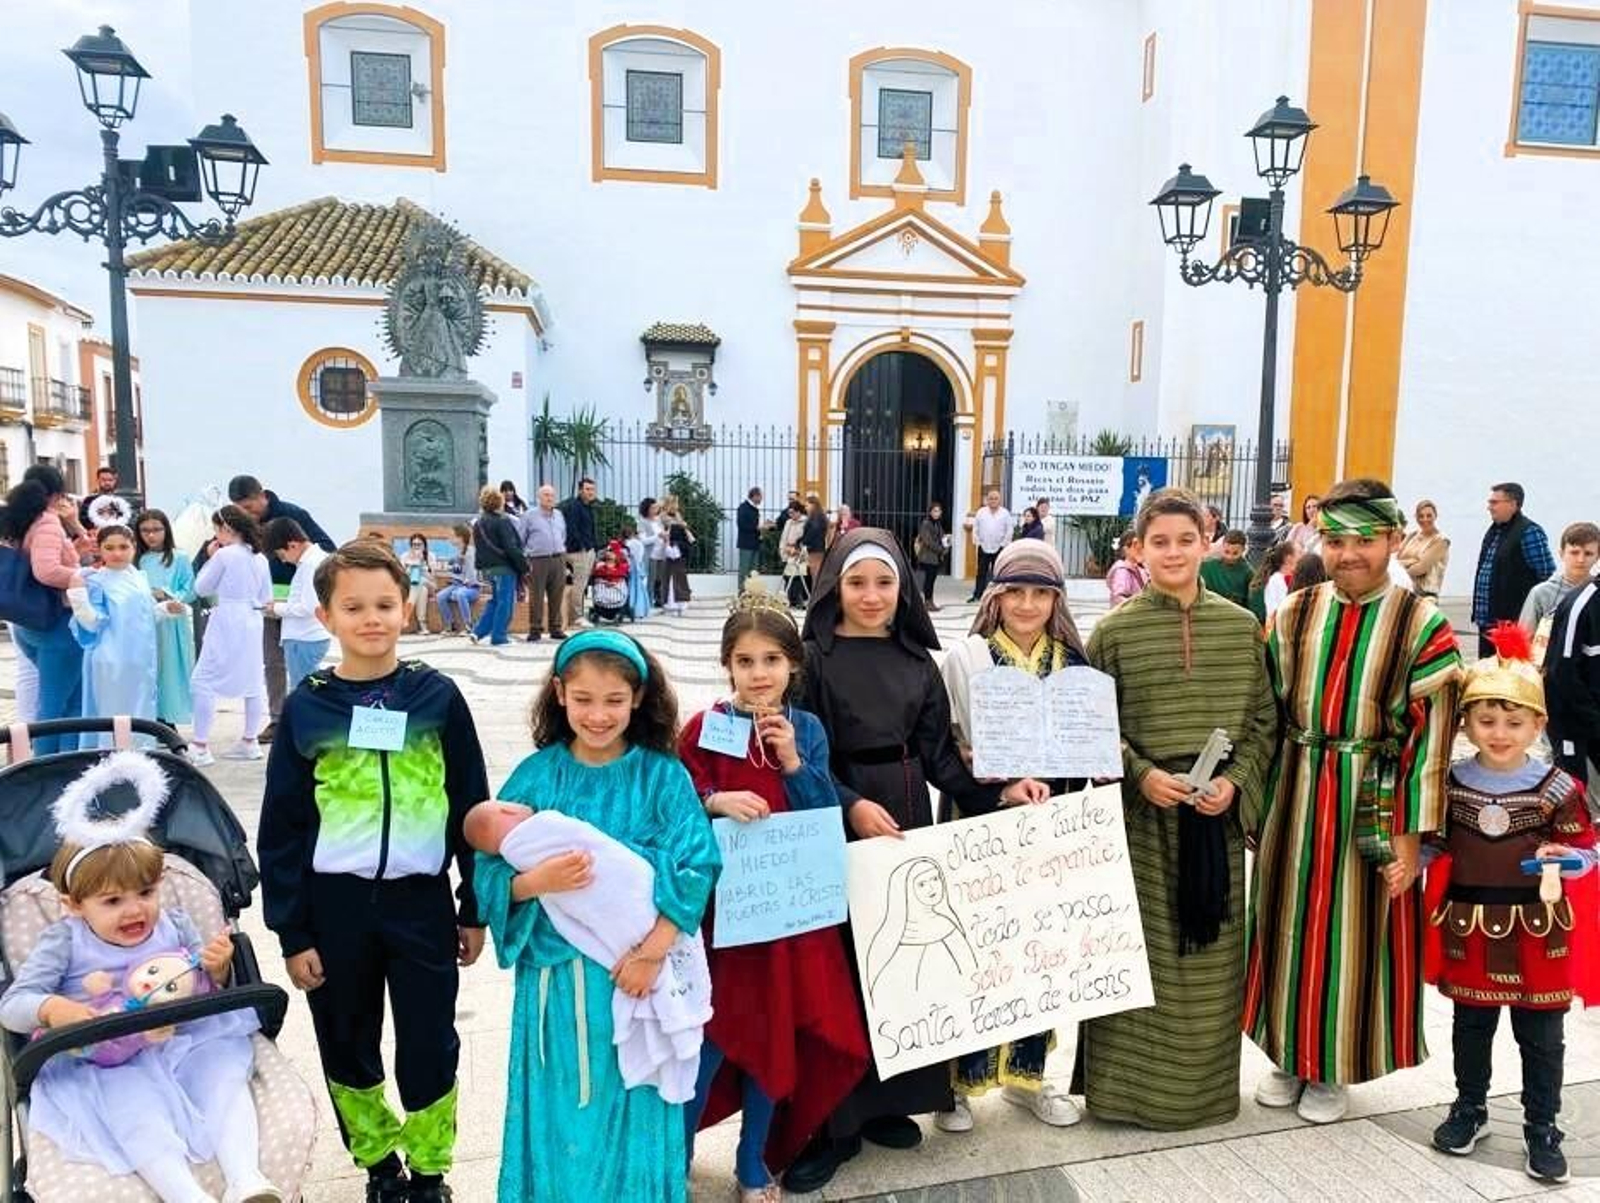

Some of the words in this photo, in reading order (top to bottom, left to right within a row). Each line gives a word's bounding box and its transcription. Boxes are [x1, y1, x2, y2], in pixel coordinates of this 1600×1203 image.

[1040, 461, 1075, 471] TENGAN
[1078, 462, 1112, 472] MIEDO!
[1049, 485, 1063, 493] los
[1080, 495, 1101, 503] PAZ
[947, 823, 1007, 871] Nada
[1016, 811, 1037, 848] te
[953, 864, 1006, 904] nada
[1012, 855, 1034, 887] te
[1032, 908, 1053, 933] se
[1023, 939, 1069, 974] Dios
[877, 1002, 964, 1060] Santa
[1038, 973, 1062, 1013] de
[1069, 961, 1132, 1003] Jesús
